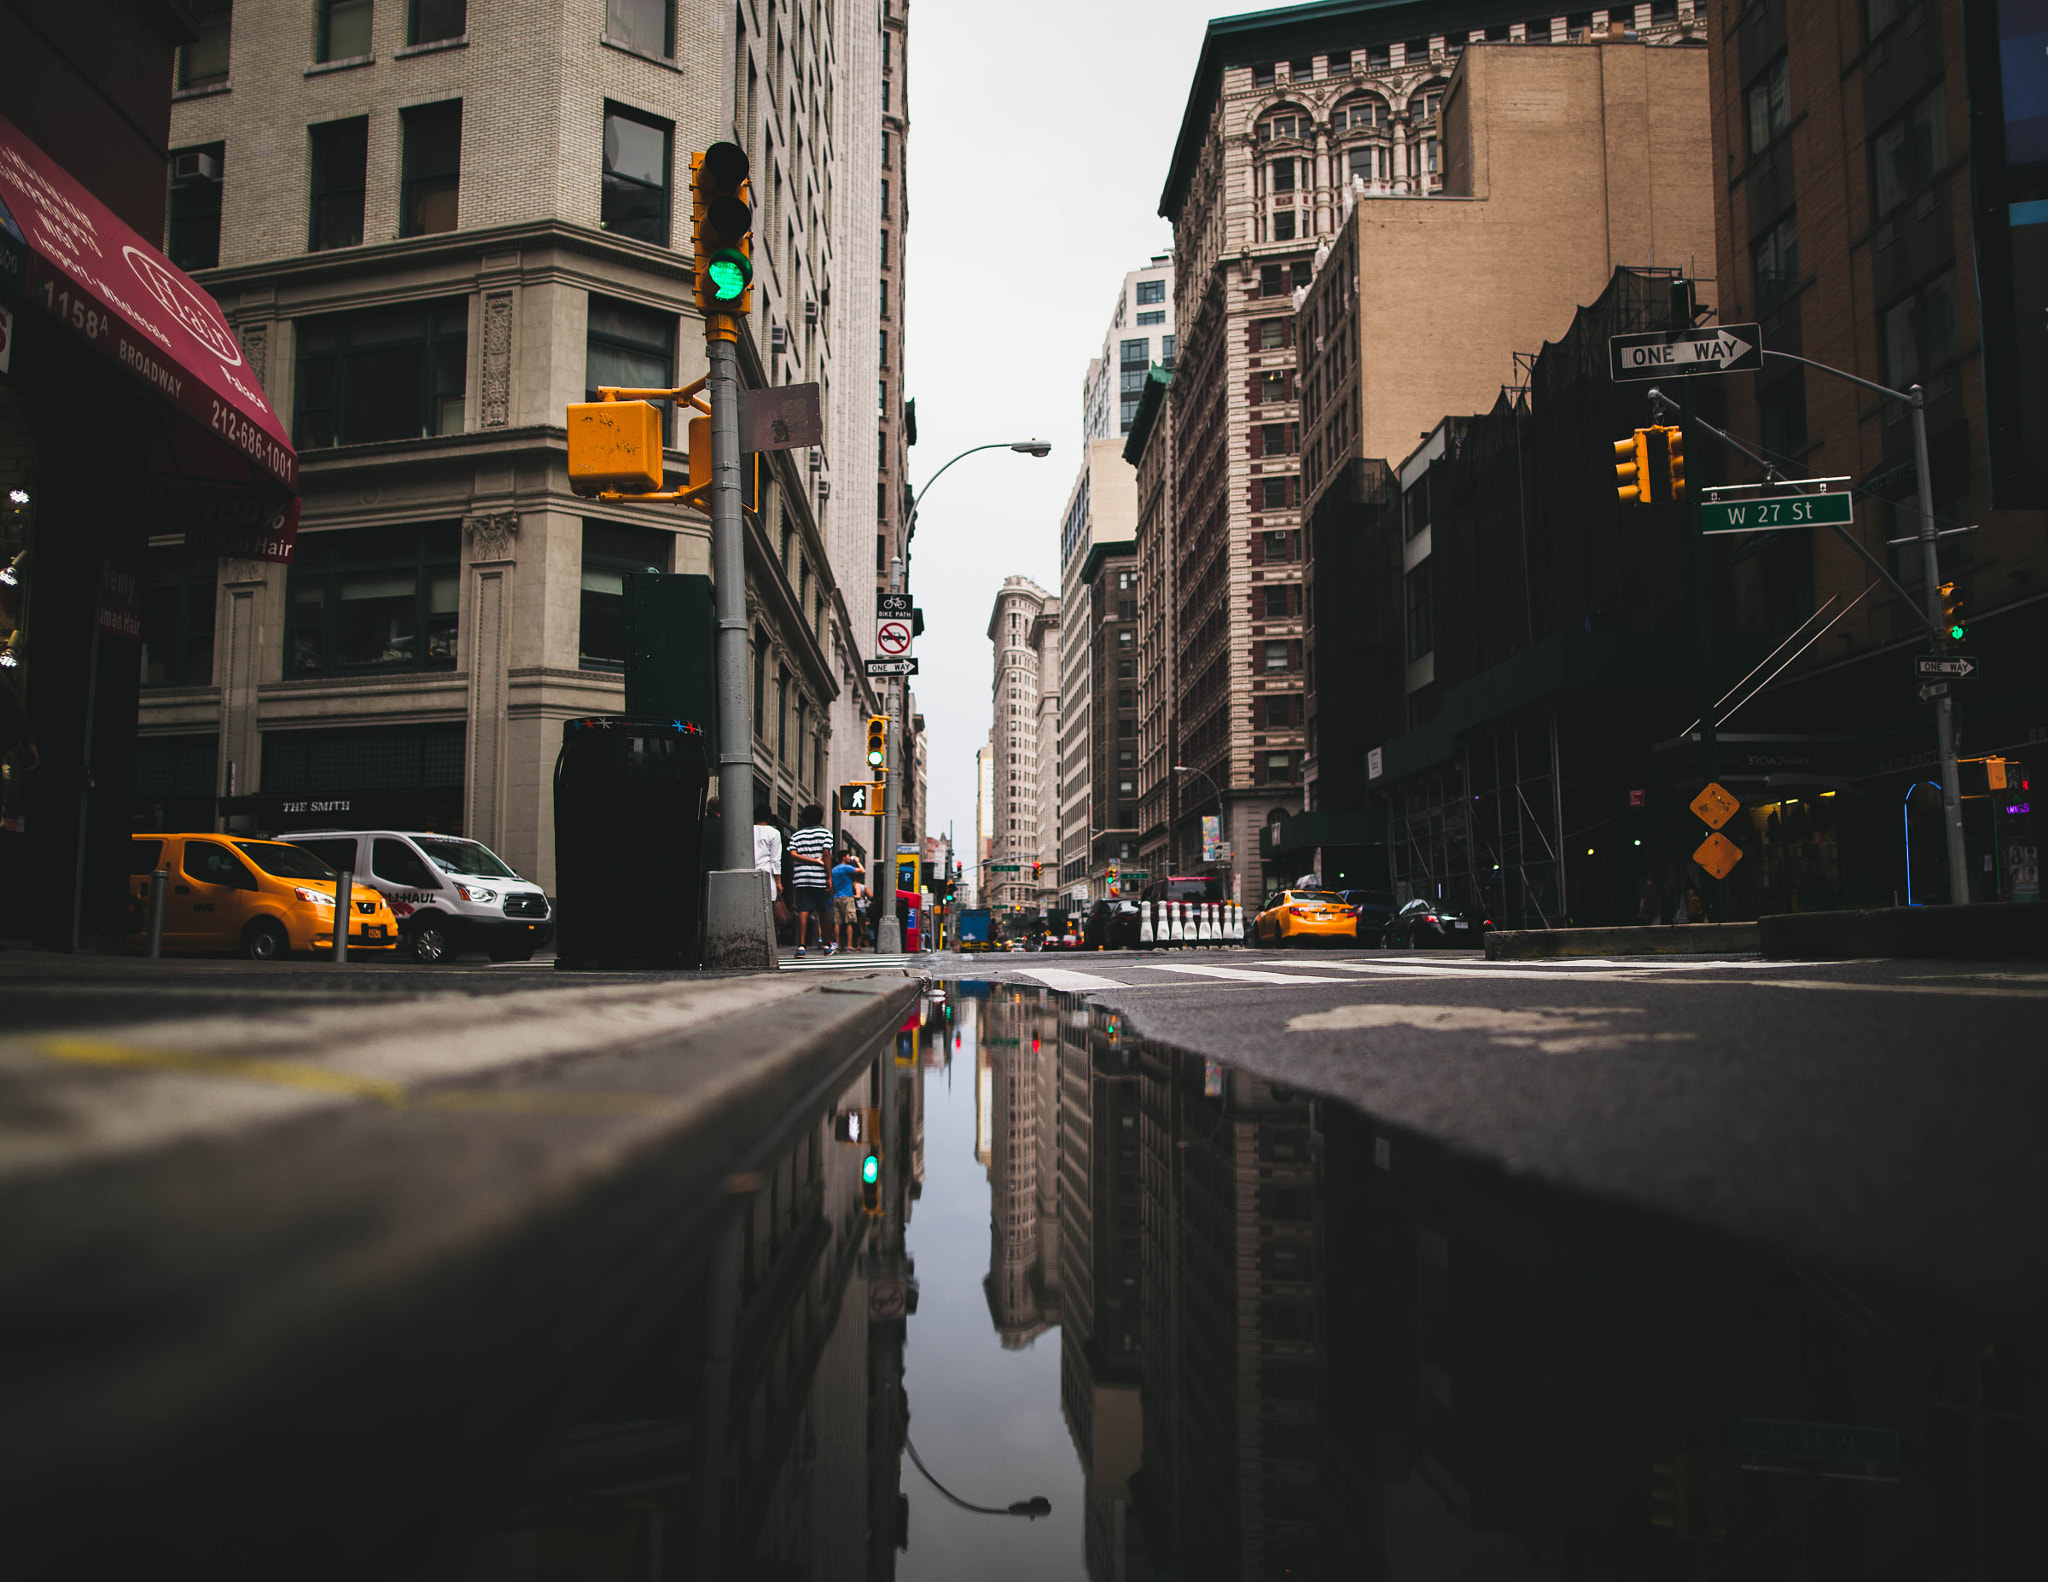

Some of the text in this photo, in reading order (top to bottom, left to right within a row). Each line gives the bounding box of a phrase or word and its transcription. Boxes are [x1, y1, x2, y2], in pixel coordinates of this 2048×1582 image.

[6, 146, 98, 237] HUMAN HAIR
[25, 181, 103, 258] PRODUCTS
[35, 209, 80, 256] WIGS
[33, 228, 92, 285] Import
[96, 278, 172, 347] Wholesale
[138, 256, 231, 357] Hair
[1632, 339, 1738, 366] ONE WAY
[220, 365, 268, 413] Palace
[119, 338, 182, 399] BROADWAY
[211, 400, 292, 482] 212-686-1001
[202, 497, 287, 530] 100%
[1727, 501, 1813, 525] W 27 St
[255, 536, 294, 557] Hair
[102, 560, 136, 605] Remy
[100, 607, 141, 636] man Hair
[872, 663, 911, 672] ONE WAY
[1924, 662, 1969, 671] ONE WAY
[1747, 755, 1810, 766] BROADWAY
[282, 800, 351, 813] THE SMITH
[2006, 802, 2030, 814] WIGS
[904, 873, 911, 881] P
[193, 902, 215, 913] NYC
[388, 892, 436, 904] U-HAUL
